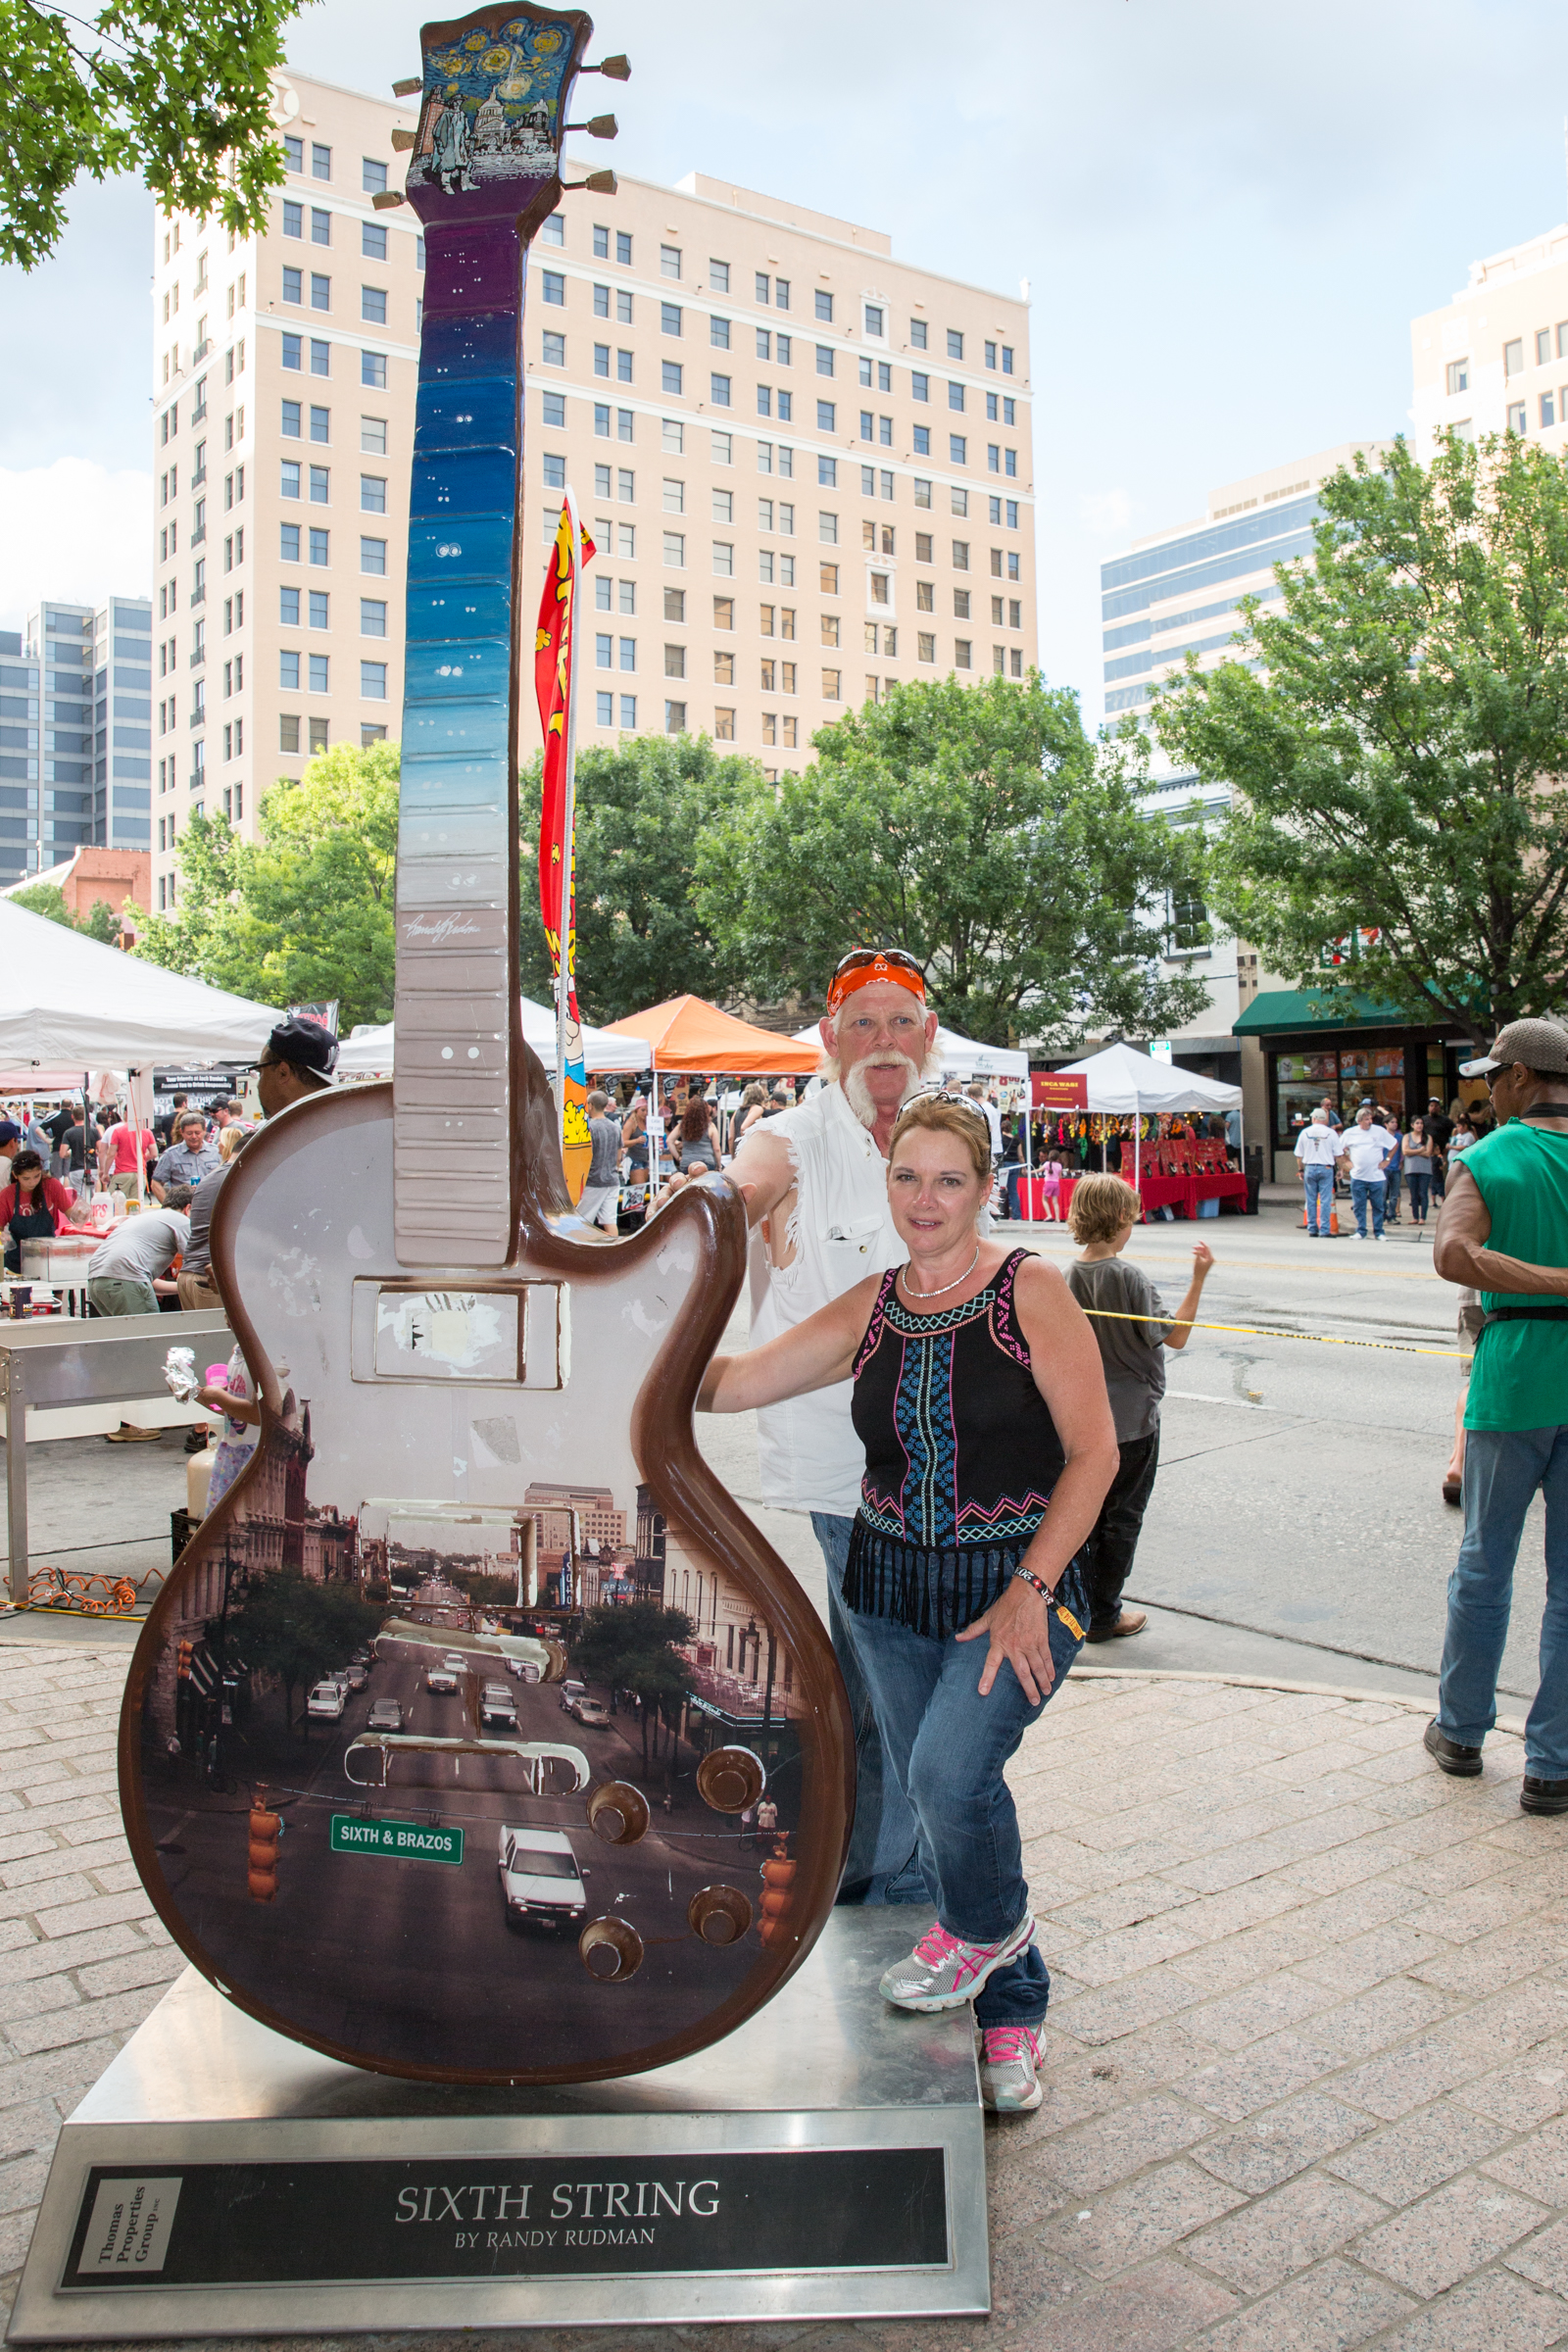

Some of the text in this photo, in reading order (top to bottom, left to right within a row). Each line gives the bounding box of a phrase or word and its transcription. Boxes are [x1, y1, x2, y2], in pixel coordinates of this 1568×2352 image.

[340, 1825, 453, 1851] SIXTH & BRAZOS
[116, 2185, 146, 2263] Properties
[394, 2180, 720, 2223] SIXTH STRING
[99, 2203, 123, 2264] Thomas
[134, 2213, 159, 2262] Group
[454, 2228, 656, 2249] BY RANDY RUDMAN
